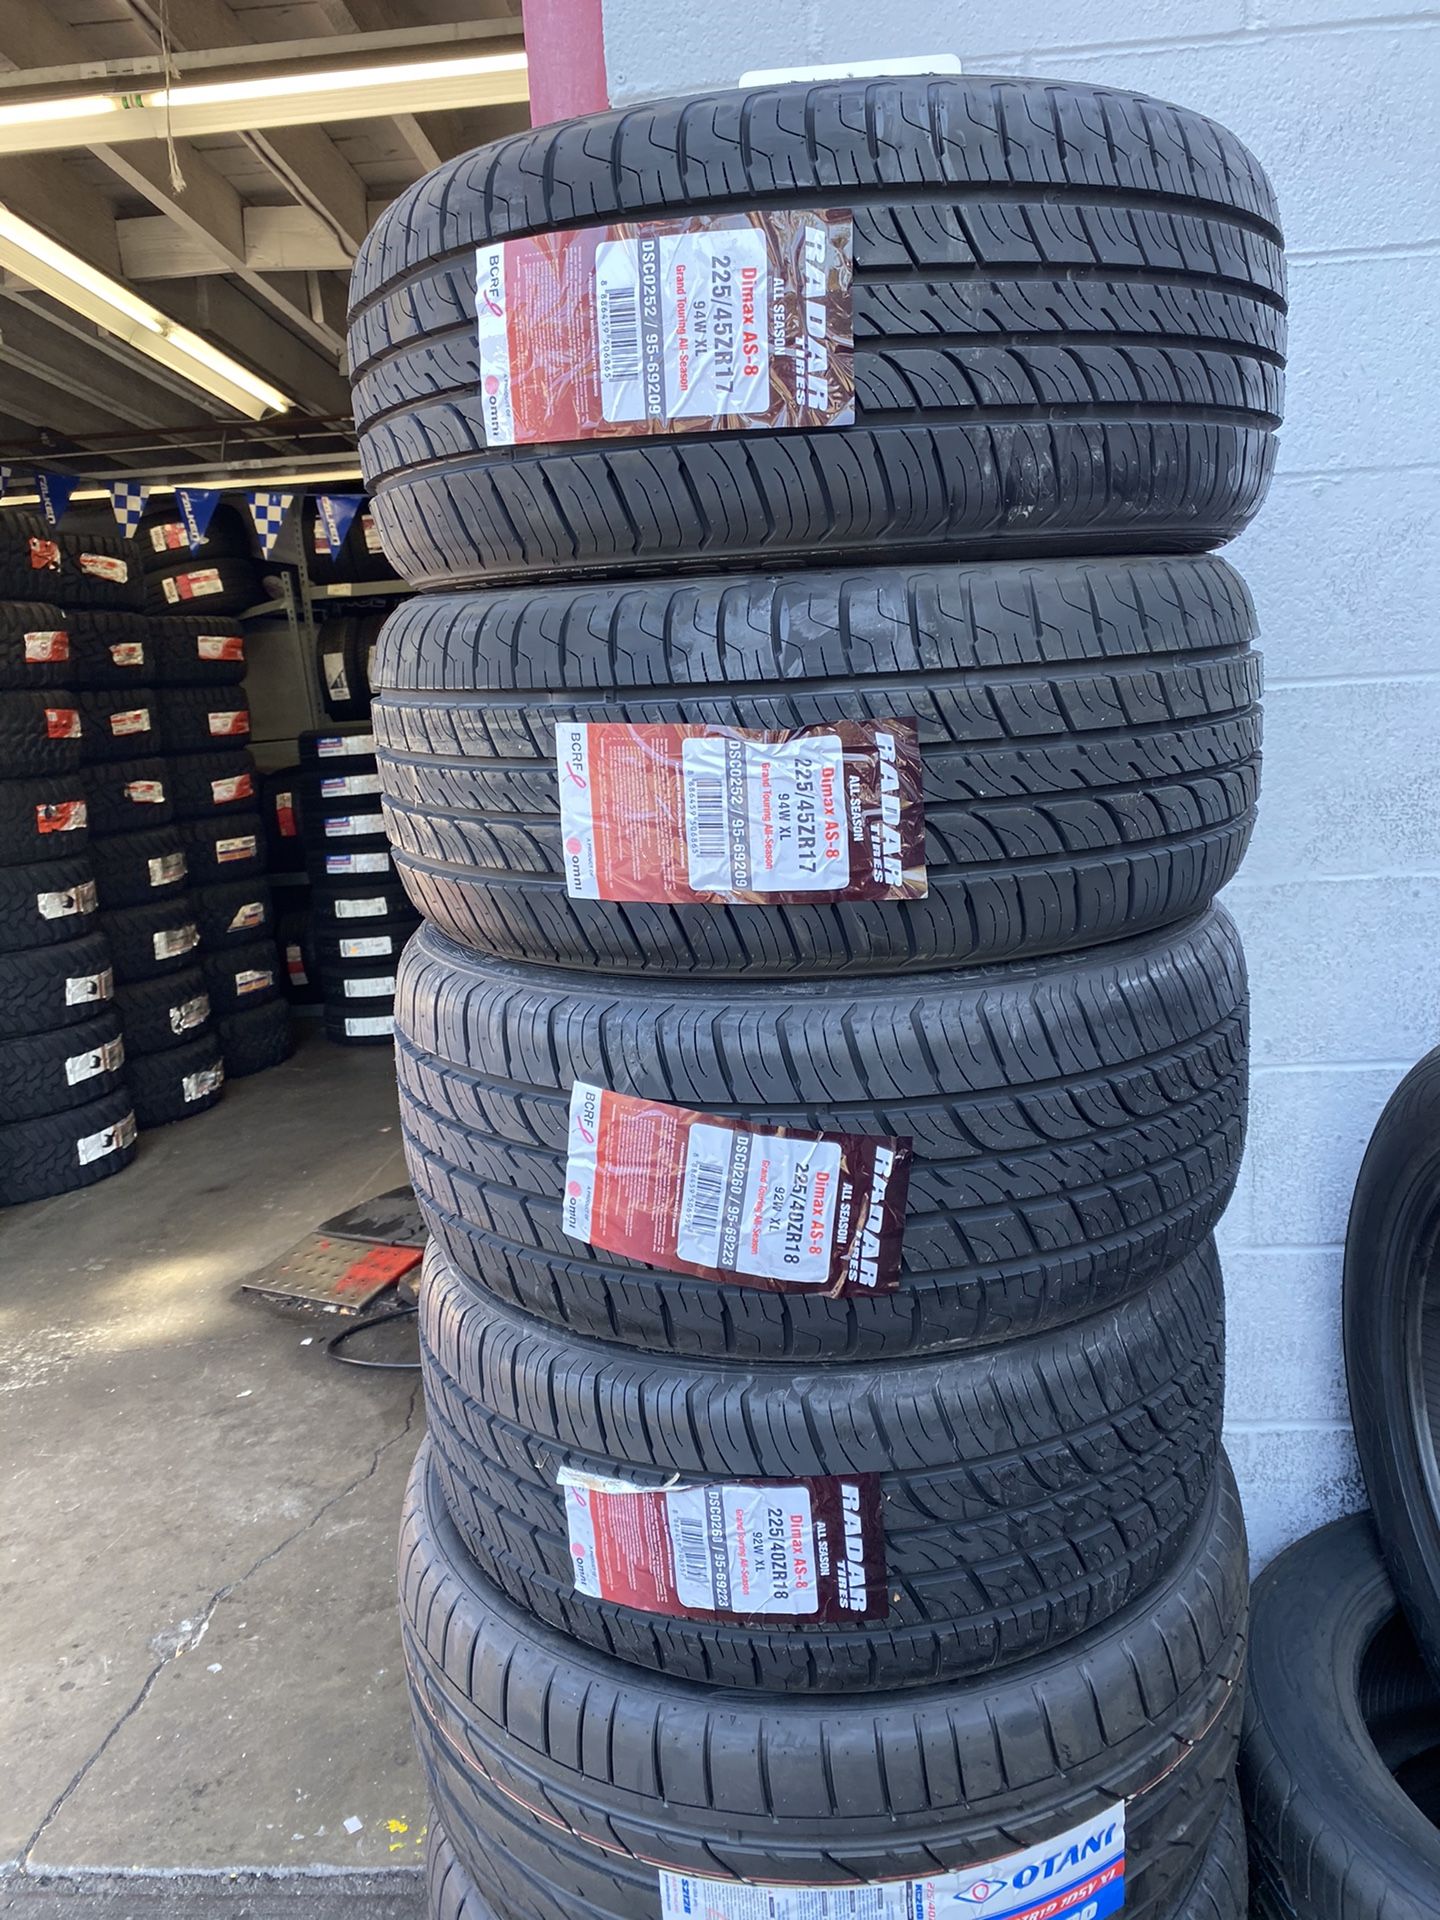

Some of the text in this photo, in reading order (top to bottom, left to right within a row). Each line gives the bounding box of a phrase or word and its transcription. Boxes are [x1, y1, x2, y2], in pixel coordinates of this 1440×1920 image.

[488, 254, 500, 298] BCRF
[641, 241, 657, 318] DSC0252
[600, 293, 609, 334] 886459
[675, 264, 690, 391] Grand Touring All-Season
[693, 300, 708, 357] 94W XL
[710, 255, 734, 393] 225/45ZR17
[740, 267, 760, 377] Dimax AS-8
[772, 276, 786, 356] ALL SEASON
[804, 226, 829, 412] RADAR
[602, 339, 611, 379] 506865
[645, 333, 662, 415] 95-69209
[793, 335, 809, 406] TIRES
[489, 395, 500, 436] omni
[38, 475, 56, 524] FALKEN
[180, 491, 200, 544] FALKEN
[320, 496, 341, 546] FALKEN
[570, 732, 583, 772] BCRF
[728, 740, 744, 806] DSC0252
[688, 781, 697, 816] 886459
[759, 762, 775, 870] Grand Touring All-Season
[778, 793, 792, 842] 94W XL
[794, 758, 817, 874] 225/45ZR17
[820, 766, 840, 860] Dimax AS-8
[849, 774, 864, 842] ALL SEASON
[875, 731, 903, 887] RADAR
[690, 820, 698, 854] 506865
[732, 818, 748, 888] 95-69209
[869, 823, 884, 884] TIRES
[571, 855, 583, 890] omni
[583, 1091, 596, 1128] BCRF
[731, 1136, 749, 1195] DSC0260
[568, 1196, 577, 1229] omni
[721, 1206, 739, 1266] 95-69223
[751, 1159, 771, 1255] Grand Touring All-Season
[768, 1185, 787, 1232] 92W XL
[783, 1162, 810, 1264] 225/40ZR18
[808, 1171, 830, 1256] Dimax AS-8
[836, 1182, 853, 1244] ALL SEASON
[858, 1145, 894, 1288] RADAR
[707, 1491, 724, 1548] DSC0260
[816, 1521, 830, 1577] ALL SEASON
[841, 1484, 868, 1613] RADAR
[714, 1553, 729, 1607] 95-69223
[752, 1532, 766, 1573] 92W XL
[767, 1508, 789, 1600] 225/40ZR18
[790, 1514, 809, 1589] Dimax AS-8
[836, 1560, 849, 1609] TIRES
[1012, 1822, 1117, 1889] OTANI
